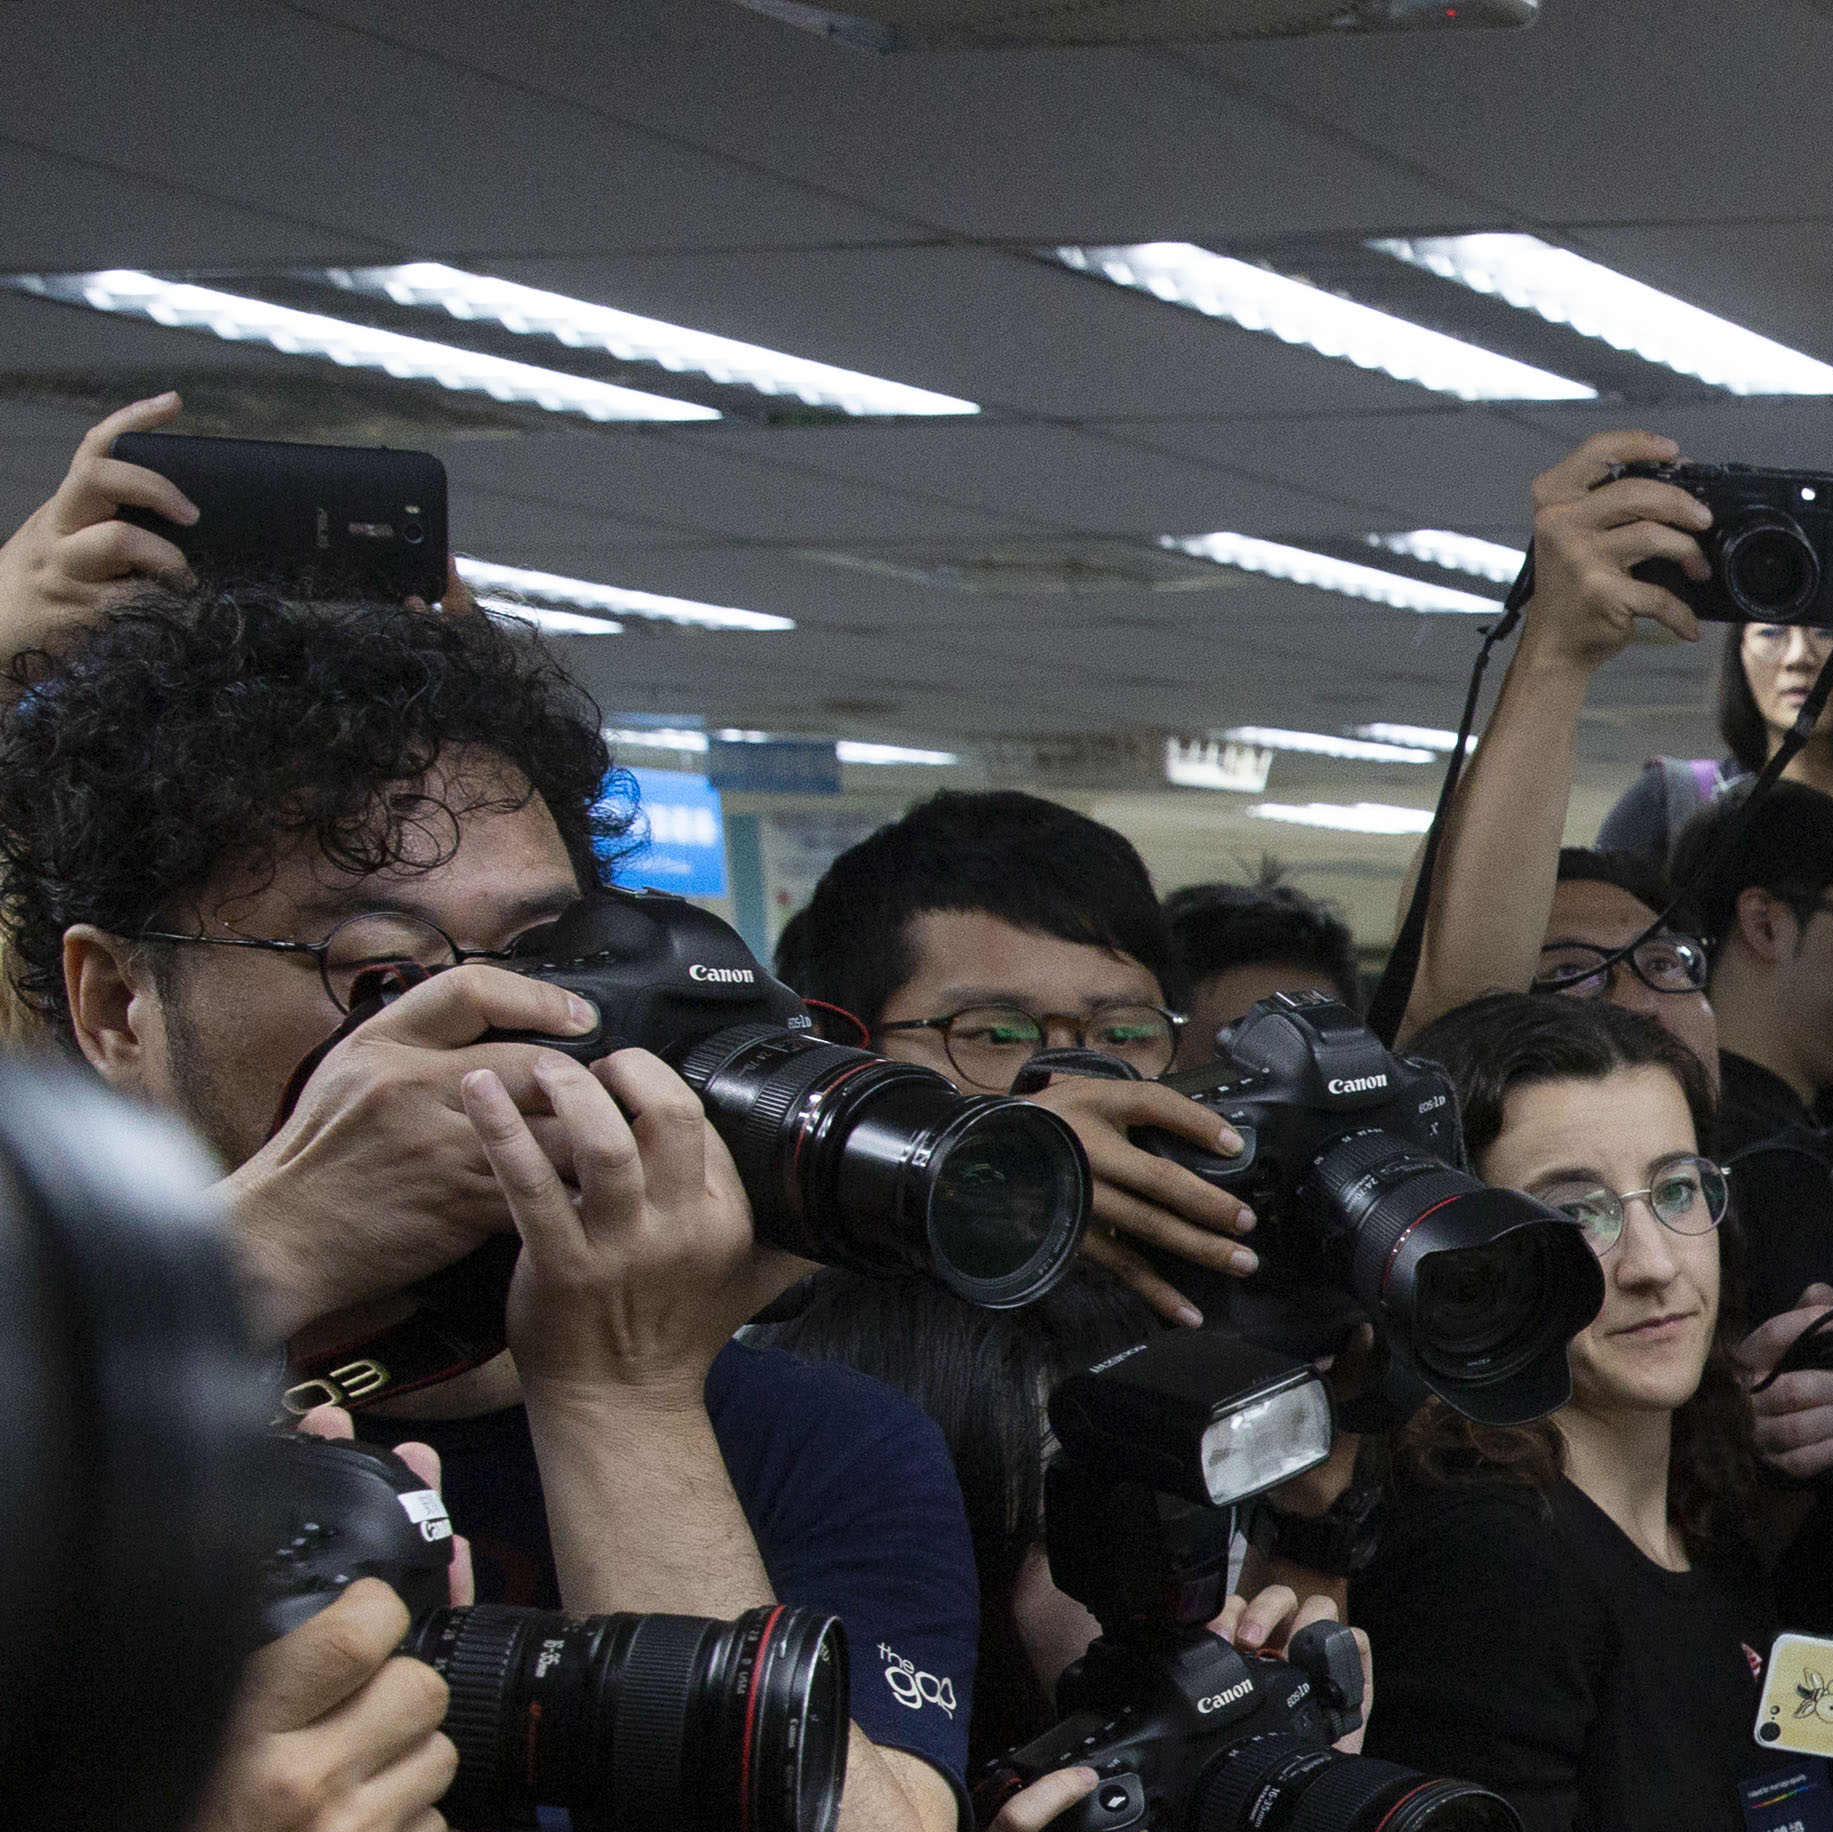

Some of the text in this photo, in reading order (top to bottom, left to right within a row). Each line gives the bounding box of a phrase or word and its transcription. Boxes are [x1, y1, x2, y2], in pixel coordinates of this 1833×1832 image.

[688, 964, 755, 984] Canon
[1328, 1073, 1388, 1095] Canon
[876, 1641, 915, 1674] the
[1197, 1678, 1254, 1714] Canon
